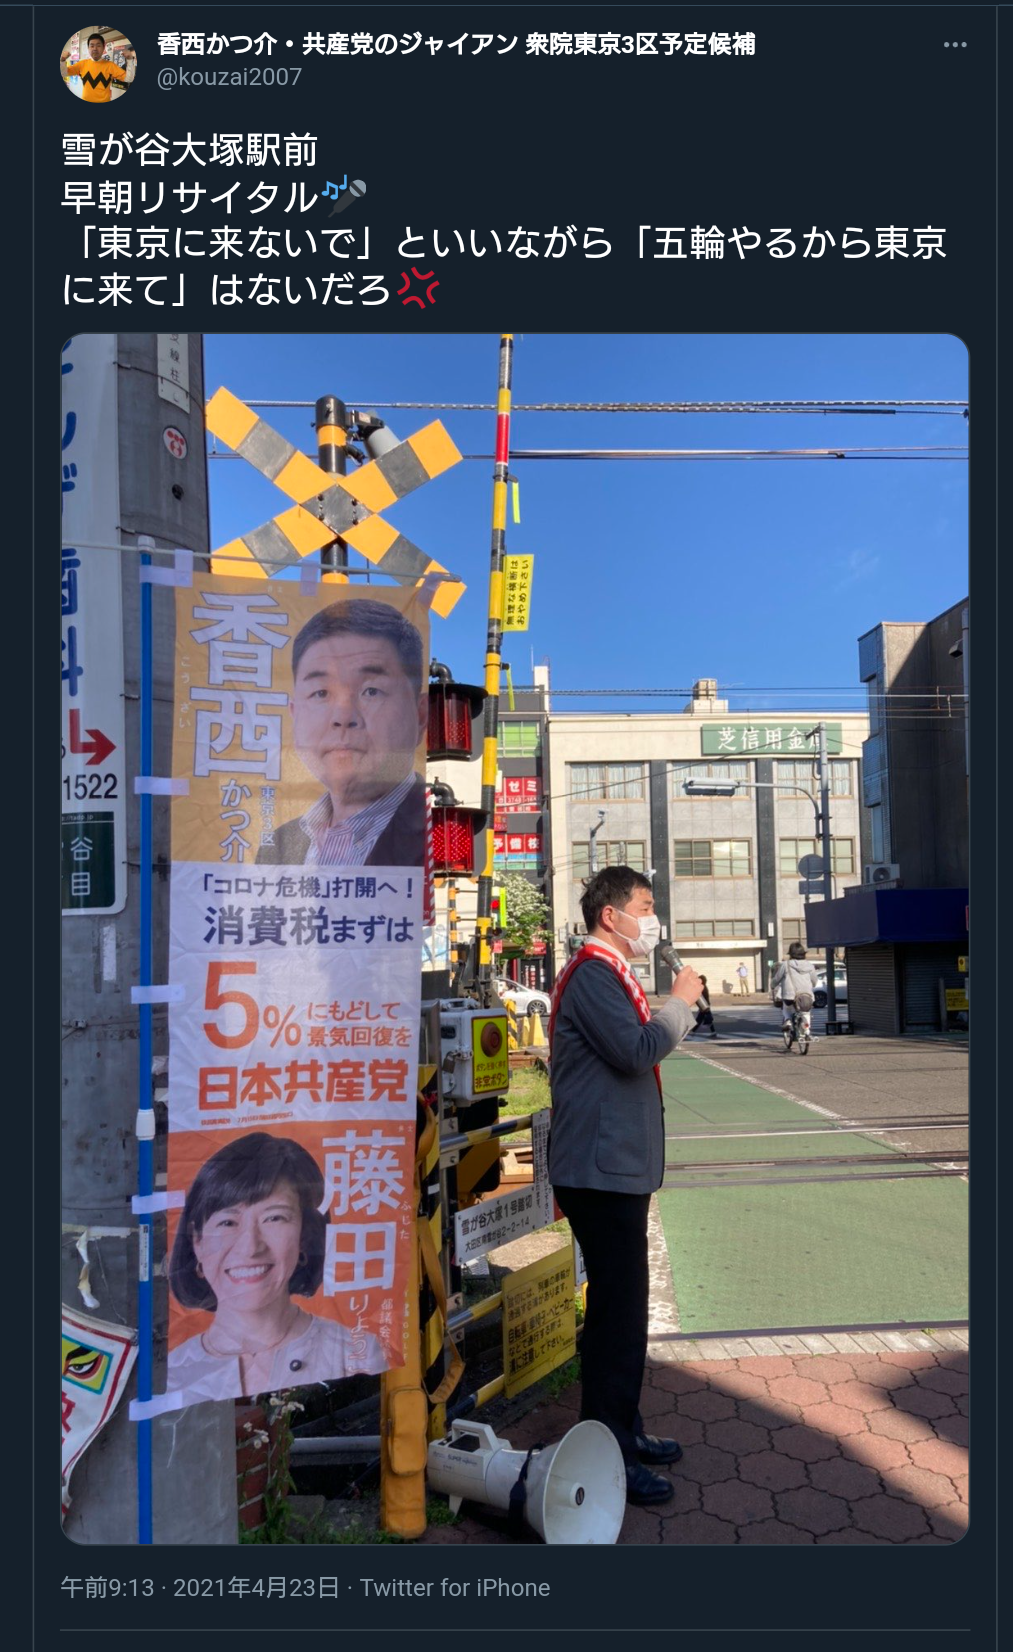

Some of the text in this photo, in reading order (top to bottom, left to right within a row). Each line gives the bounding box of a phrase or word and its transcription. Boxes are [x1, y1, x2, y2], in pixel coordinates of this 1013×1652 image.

[516, 559, 529, 626] おやめ下さい
[189, 591, 291, 781] 香西
[63, 773, 118, 800] 1522
[509, 780, 537, 793] ゼミ
[220, 779, 252, 863] かつ介
[260, 786, 276, 847] 東京3区
[203, 904, 414, 947] 消費税まずは
[203, 961, 302, 1049] 5%
[307, 1001, 401, 1022] にもどして
[307, 1025, 413, 1048] 景気回復を
[198, 1058, 409, 1112] 日本共産党
[475, 1072, 506, 1089] 非常ボタン
[317, 1129, 406, 1297] 藤田
[400, 1200, 412, 1240] ふじた
[461, 1194, 533, 1237] 雪が谷大塚1号踏切
